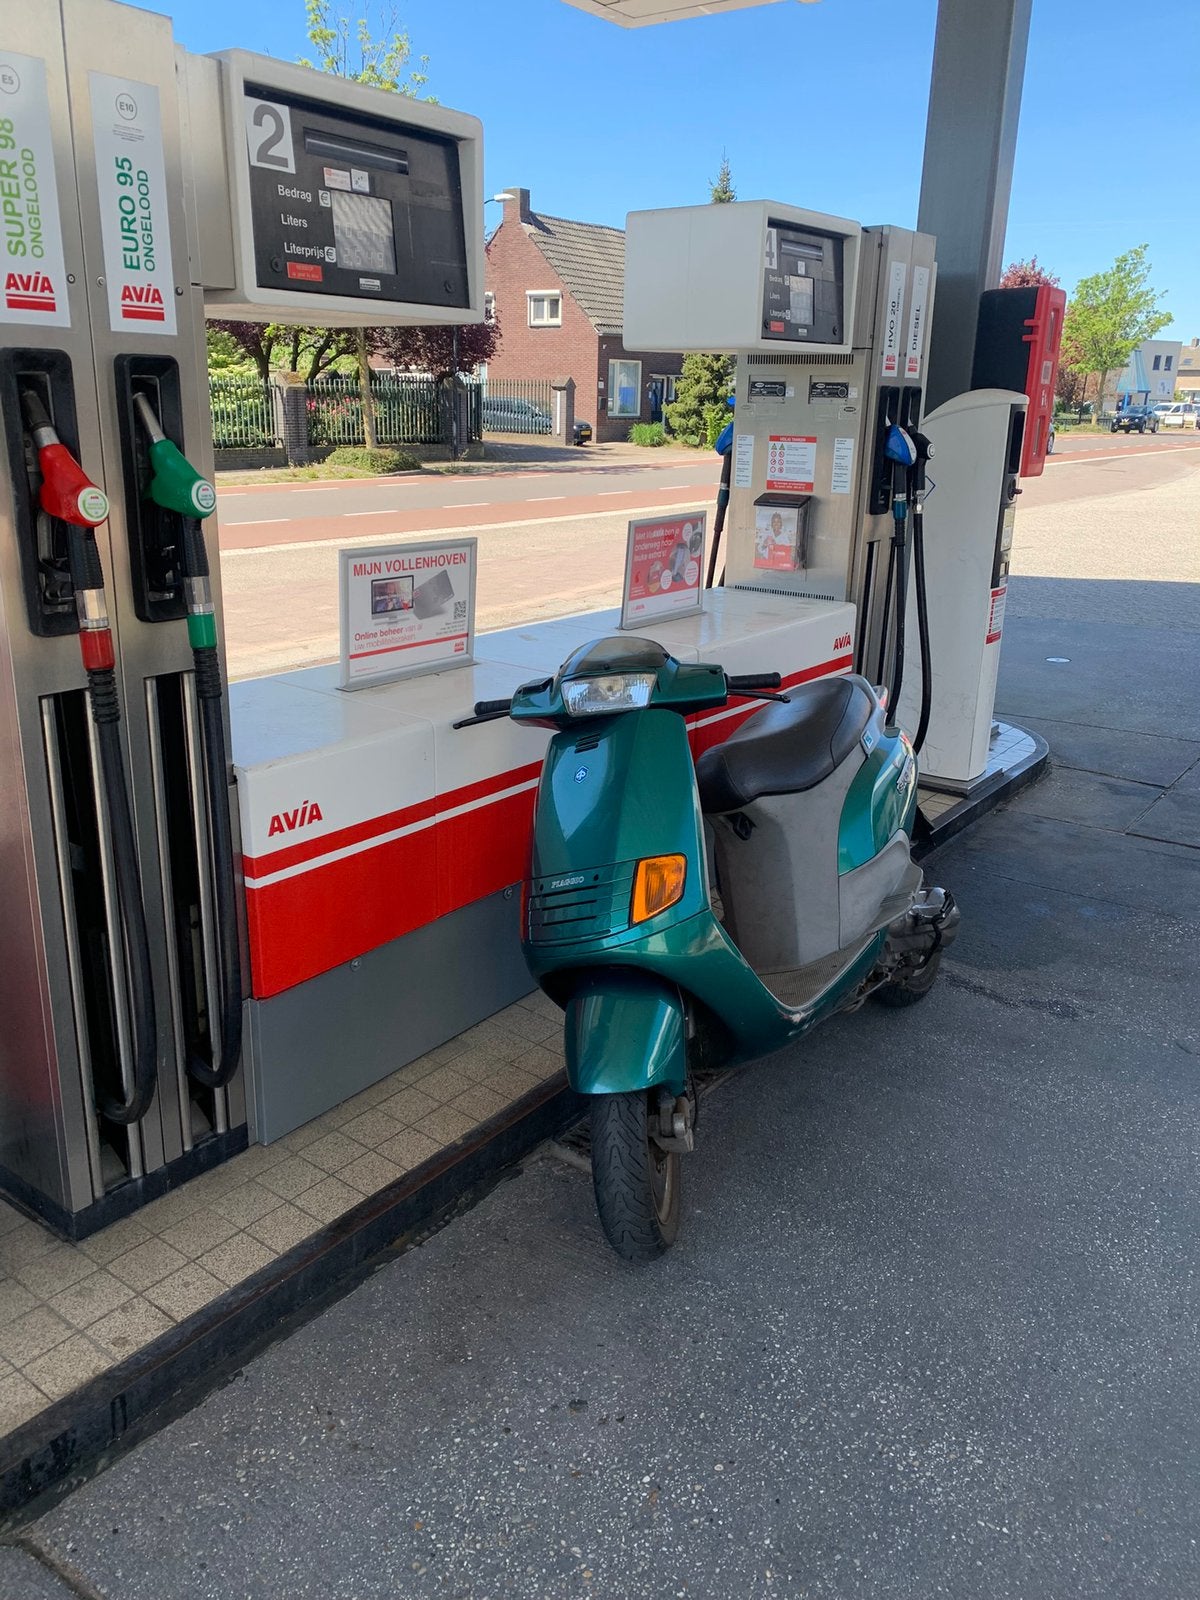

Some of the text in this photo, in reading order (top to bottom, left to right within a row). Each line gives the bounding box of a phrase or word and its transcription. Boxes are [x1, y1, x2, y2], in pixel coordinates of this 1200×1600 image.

[1, 74, 14, 85] E5
[119, 101, 135, 113] E10
[252, 103, 290, 168] 2
[114, 156, 134, 187] 95
[0, 118, 27, 257] SUPER 98
[277, 184, 312, 203] Bedrag
[20, 148, 45, 259] ONGELOOD
[117, 194, 141, 271] EURO
[136, 169, 156, 272] ONGELOOD
[280, 213, 308, 228] Liters
[283, 242, 325, 259] Literprijs
[765, 230, 775, 266] 4
[891, 301, 897, 316] 20
[912, 305, 920, 351] DIESEL
[353, 552, 467, 576] MIJN VOLLENHOVEN
[354, 632, 378, 642] Online
